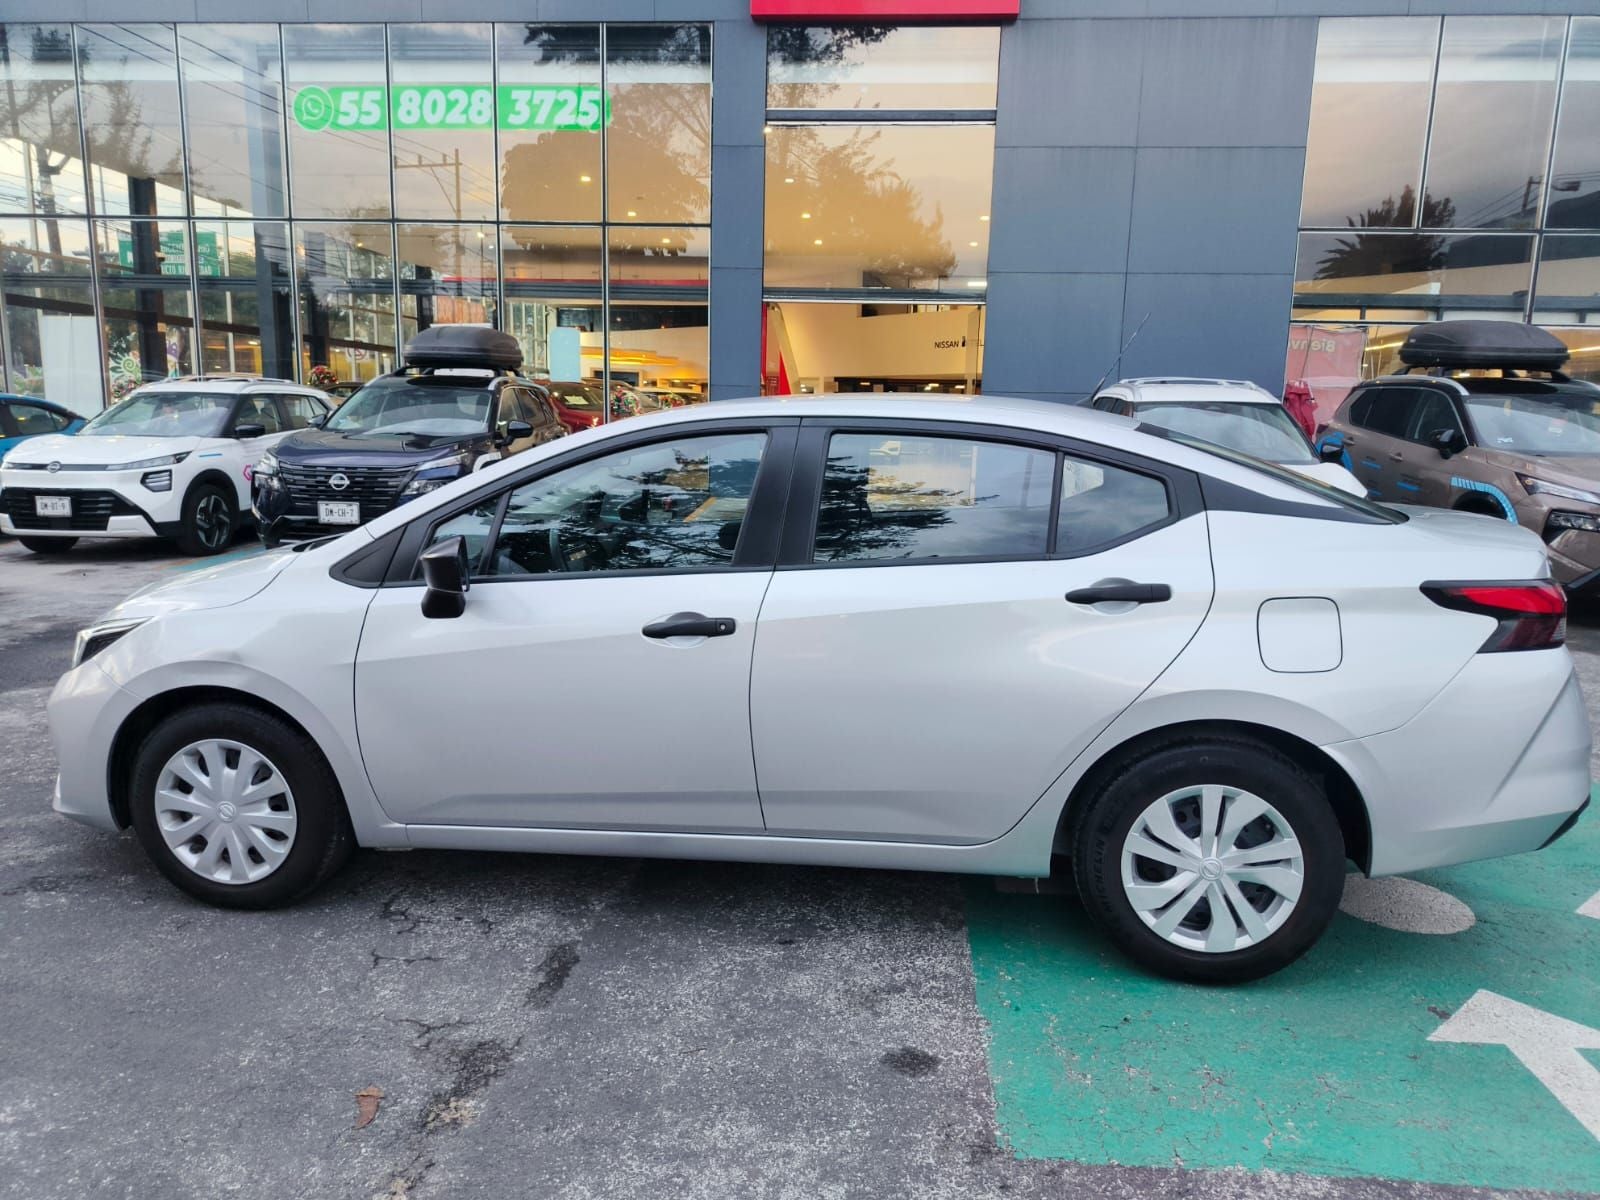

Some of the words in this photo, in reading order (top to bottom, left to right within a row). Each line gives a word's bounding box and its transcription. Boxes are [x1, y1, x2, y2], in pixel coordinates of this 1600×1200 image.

[338, 90, 382, 126] 55
[397, 89, 493, 125] 8028
[507, 90, 601, 126] 3725
[934, 340, 960, 349] NISSAN
